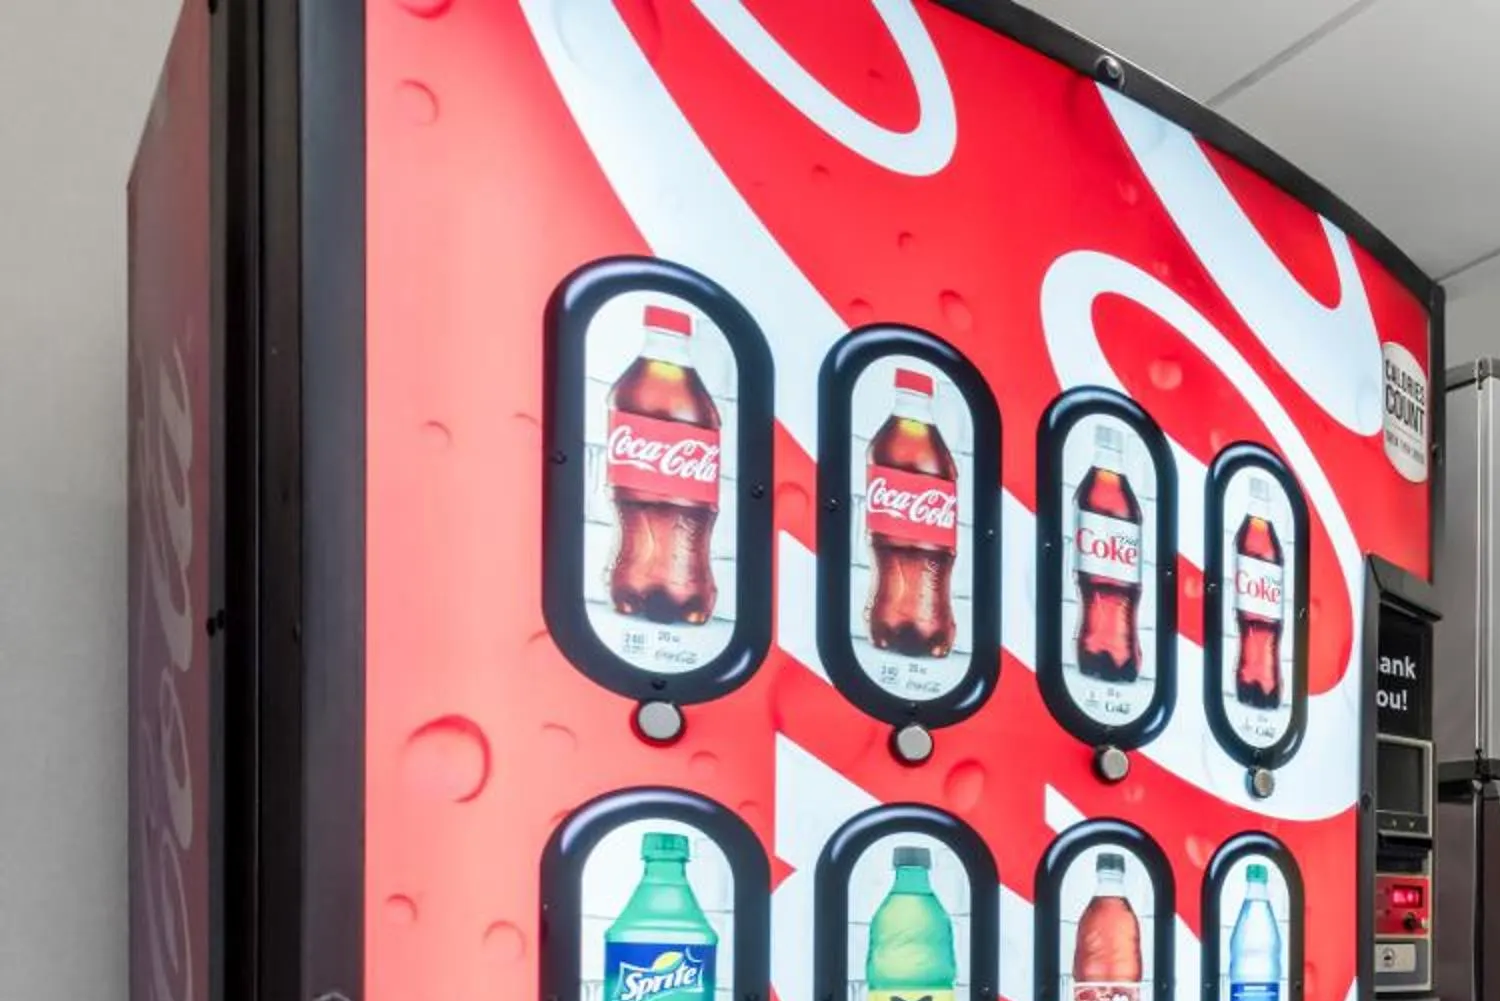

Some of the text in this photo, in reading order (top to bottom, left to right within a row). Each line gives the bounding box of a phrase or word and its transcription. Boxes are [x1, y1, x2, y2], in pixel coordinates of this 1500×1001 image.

[1385, 384, 1425, 436] COUNT
[608, 424, 720, 483] Coca-Cola
[866, 477, 957, 529] Coca-Cola
[1075, 527, 1138, 567] Coke
[1234, 569, 1282, 604] Coke
[1379, 655, 1417, 680] ank
[1376, 689, 1409, 711] ou!
